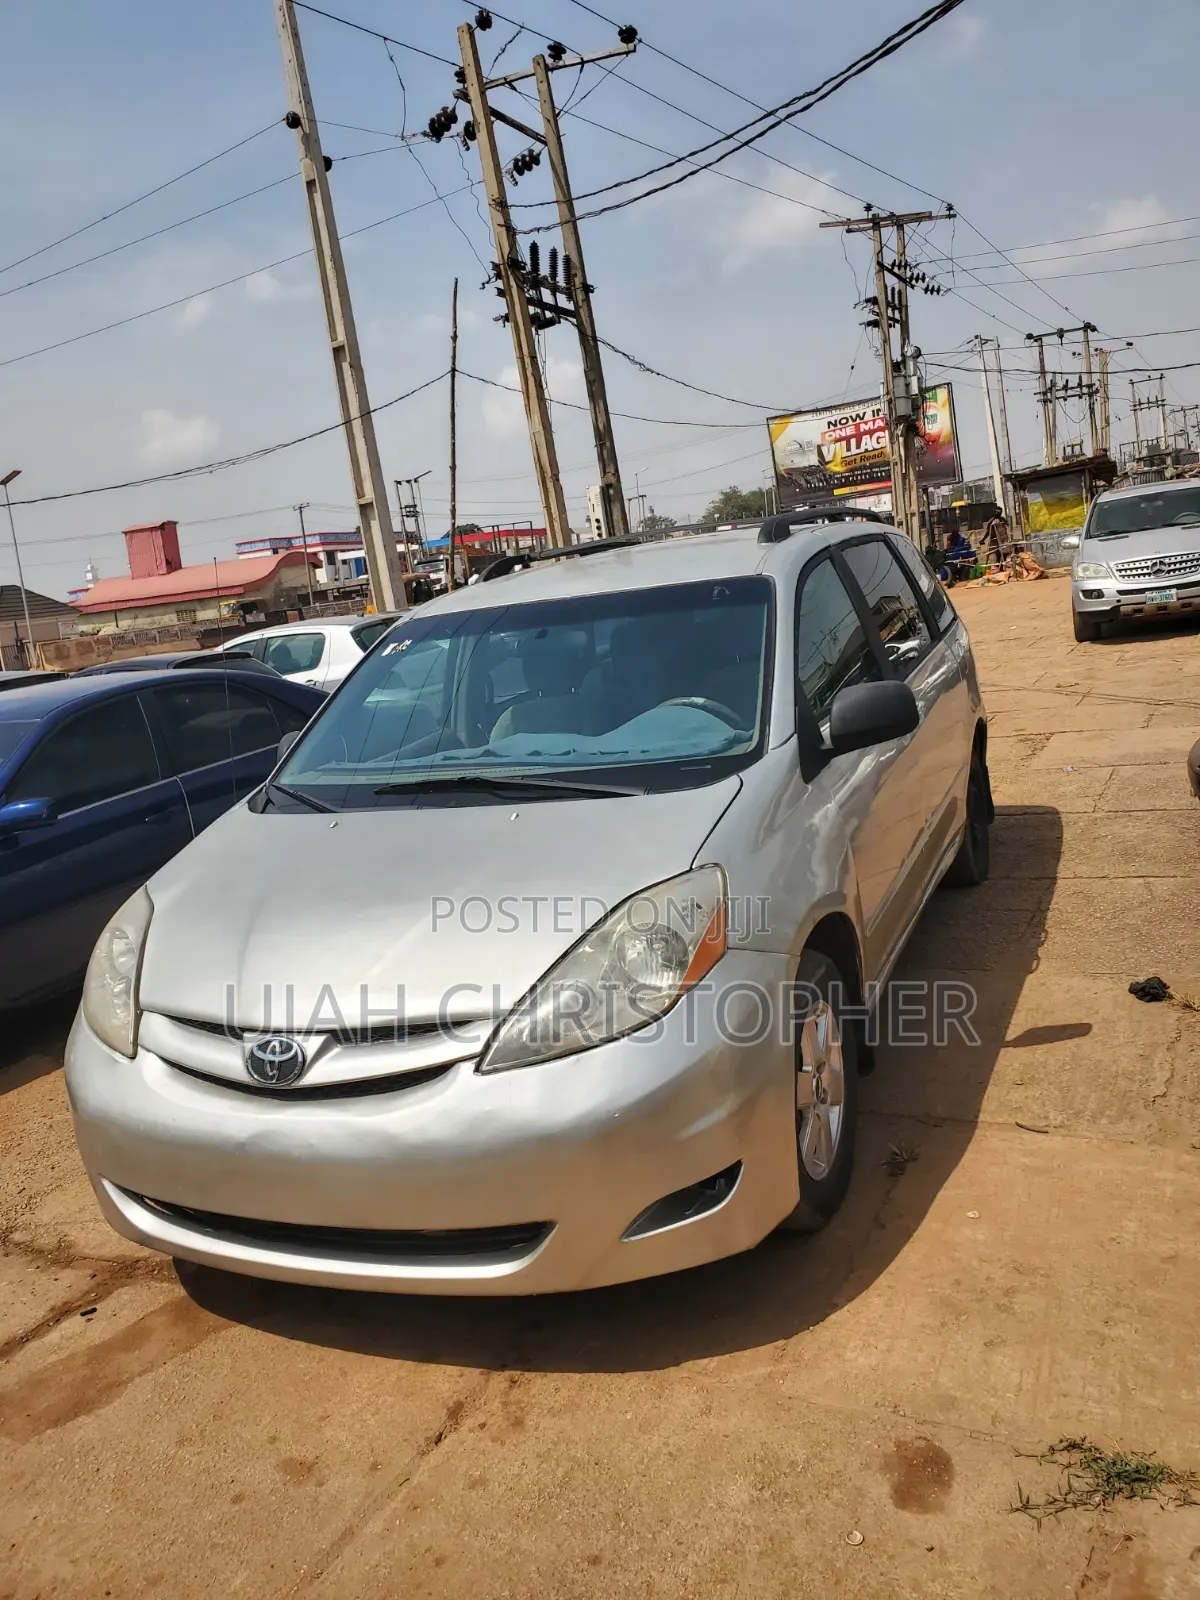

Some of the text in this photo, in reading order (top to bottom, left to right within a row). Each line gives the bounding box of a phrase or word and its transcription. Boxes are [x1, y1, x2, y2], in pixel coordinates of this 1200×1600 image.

[827, 411, 866, 429] NOW
[825, 419, 885, 441] ONE MA
[841, 458, 857, 467] Get
